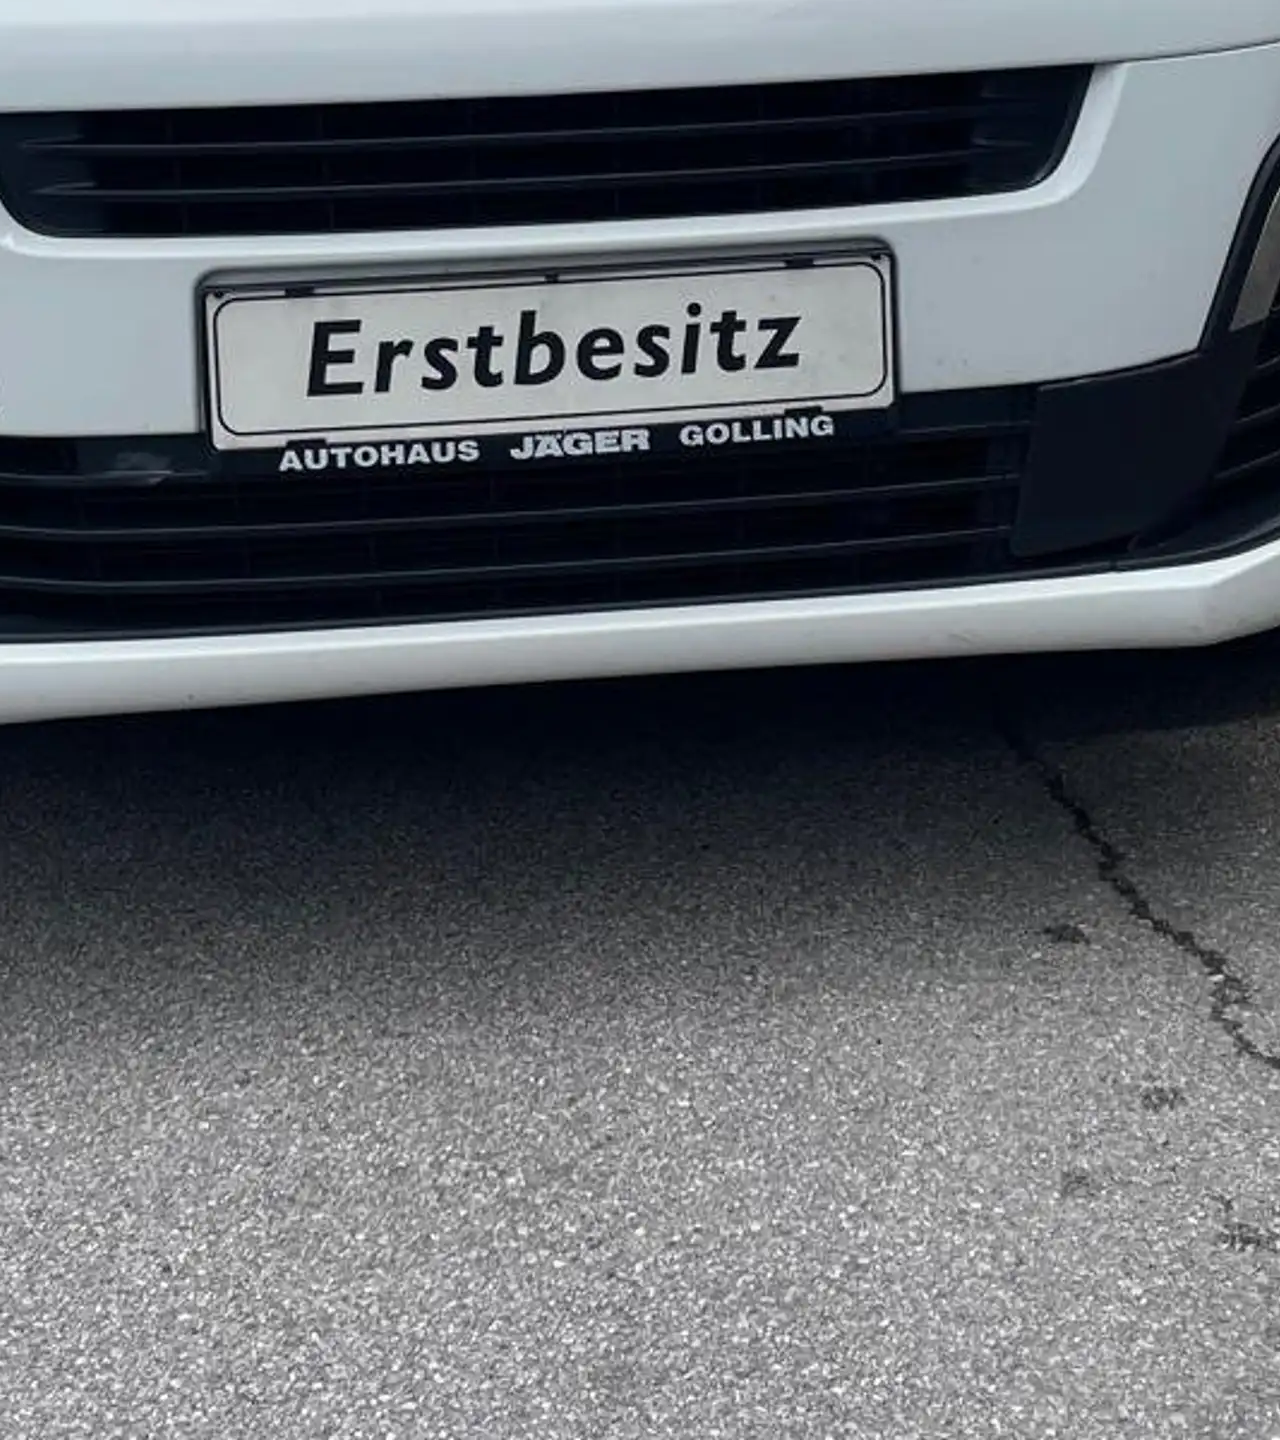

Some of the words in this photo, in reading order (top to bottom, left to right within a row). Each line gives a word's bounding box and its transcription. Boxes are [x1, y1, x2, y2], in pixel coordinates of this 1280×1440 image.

[306, 302, 802, 398] Erstbesitz
[278, 439, 481, 473] AUTOHAUS
[510, 426, 651, 461] JÄGER
[678, 414, 836, 447] GOLLING
